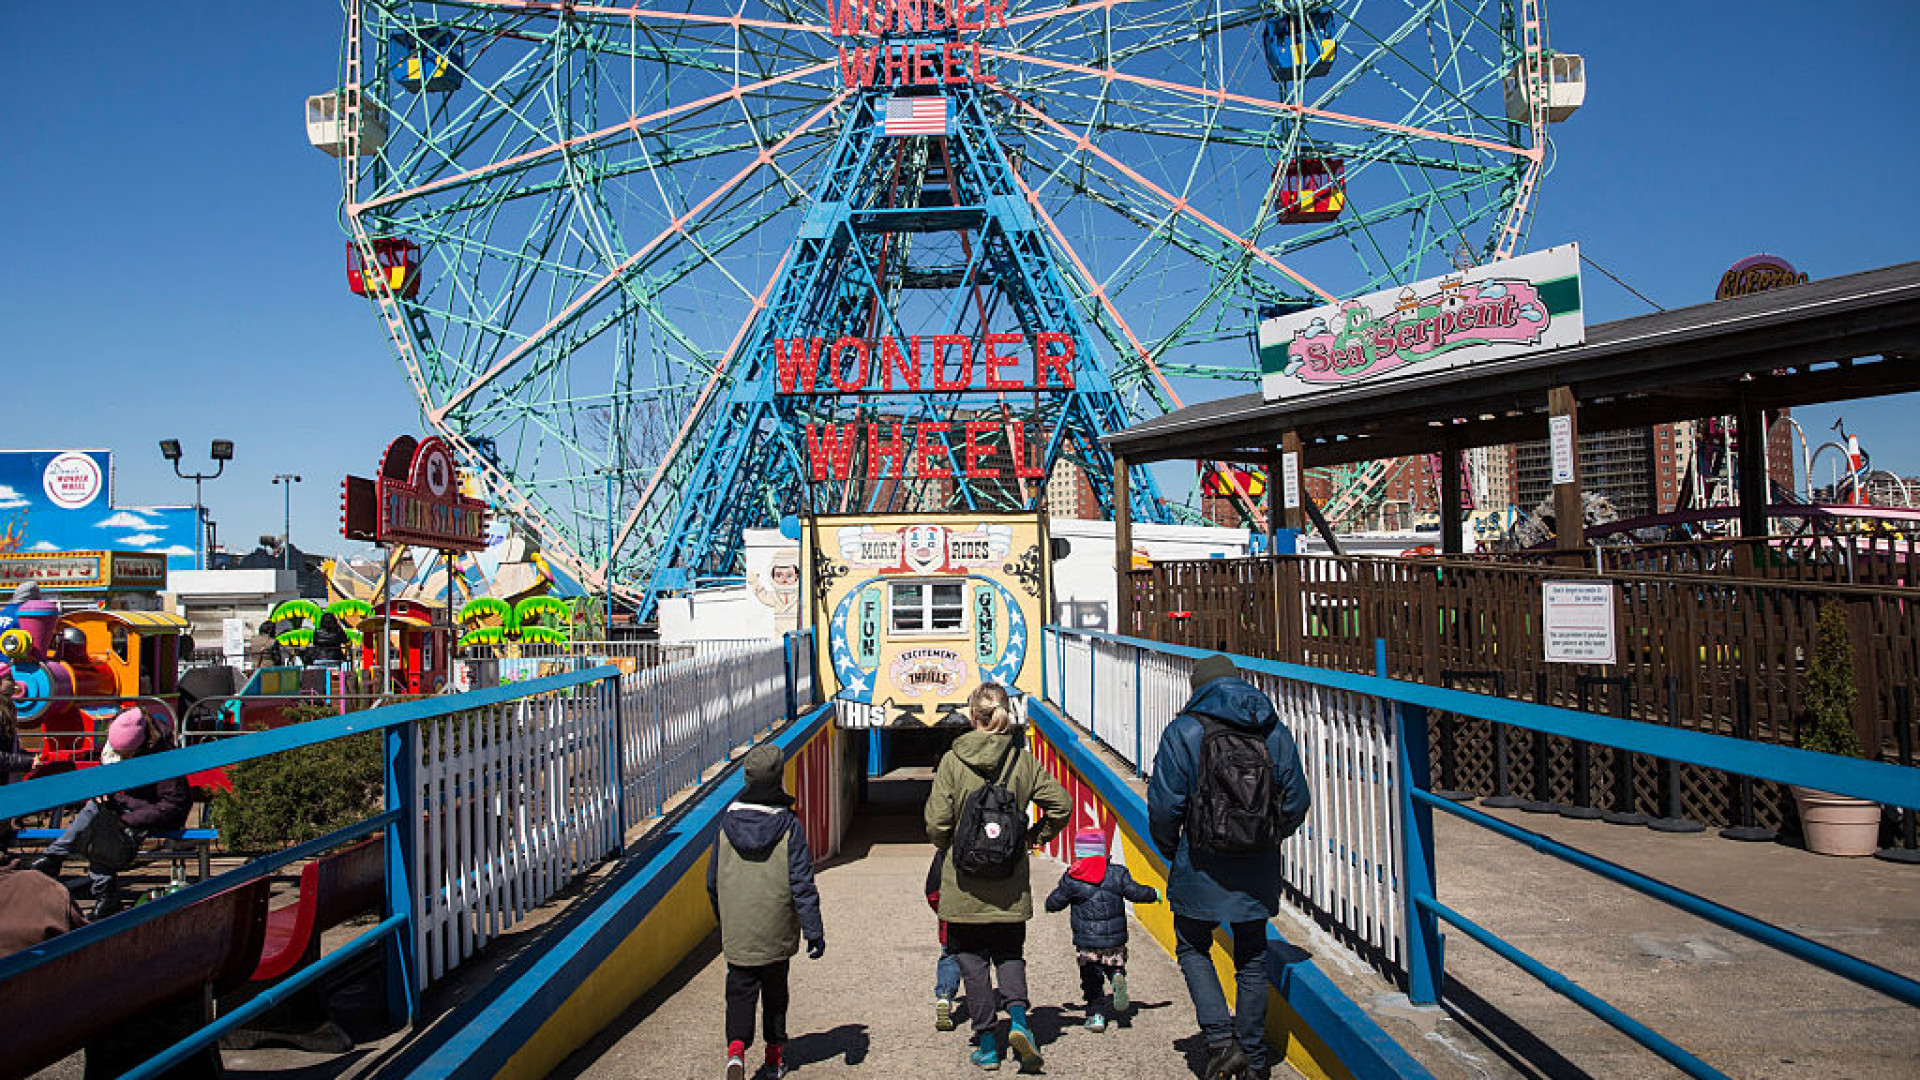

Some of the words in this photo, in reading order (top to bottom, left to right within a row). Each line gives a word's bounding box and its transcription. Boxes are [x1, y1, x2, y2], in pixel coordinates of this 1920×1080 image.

[826, 0, 1008, 36] WONDER
[839, 41, 998, 87] WHEEL
[1306, 342, 1367, 371] Sea
[1372, 296, 1519, 358] Serpent
[774, 332, 1076, 394] WONDER
[806, 421, 1045, 480] WHEEL
[0, 561, 92, 578] ICKETS
[861, 541, 897, 559] MORE
[951, 541, 989, 559] RIDES
[863, 601, 875, 657] FUN
[978, 591, 993, 657] GAMES
[901, 649, 958, 662] EXCITEMENT
[907, 671, 949, 685] THRILLS
[836, 698, 886, 728] THIS
